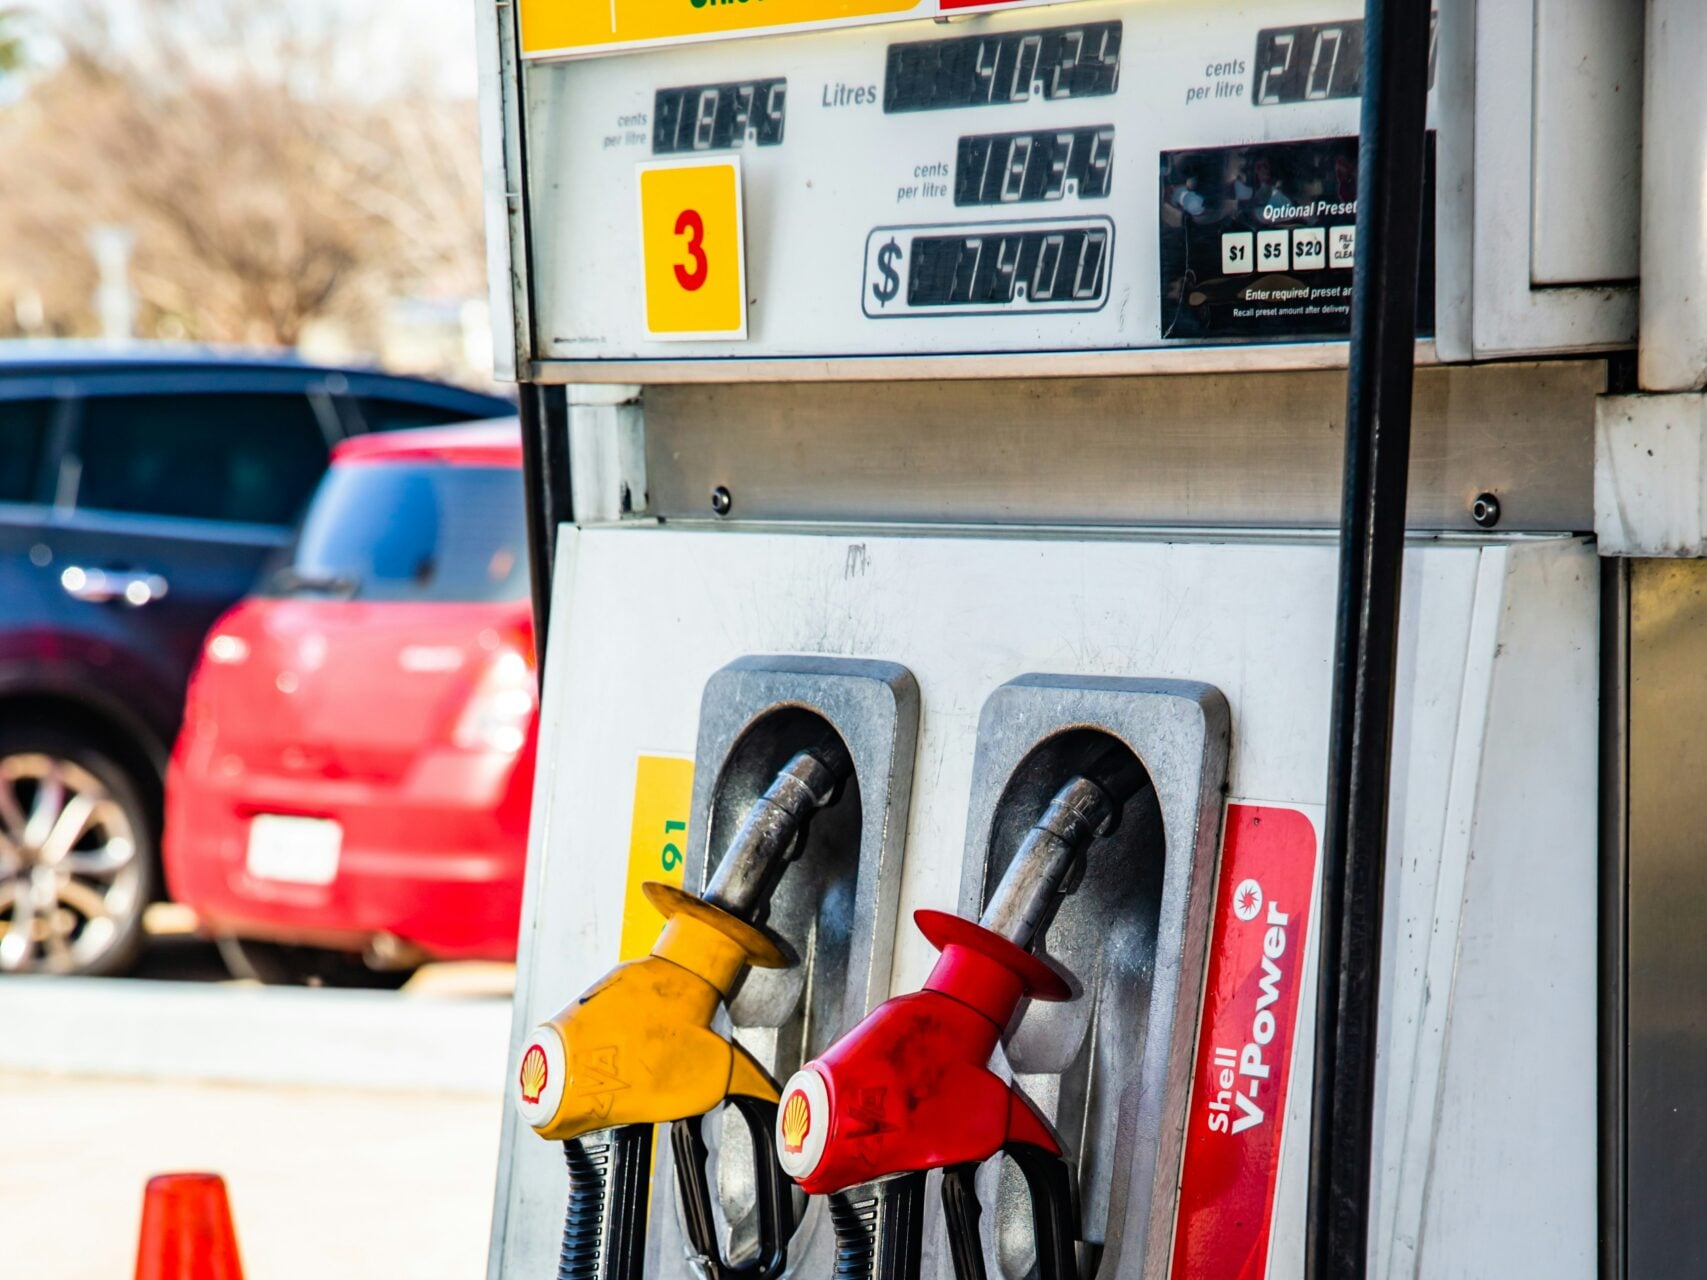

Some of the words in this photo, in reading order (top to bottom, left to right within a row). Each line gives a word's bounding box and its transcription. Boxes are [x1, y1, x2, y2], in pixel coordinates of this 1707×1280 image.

[1205, 59, 1246, 78] cents
[821, 83, 877, 108] Litres
[1186, 86, 1210, 104] per
[1215, 80, 1244, 99] litre
[617, 113, 648, 128] cents
[604, 135, 621, 149] per
[625, 131, 647, 145] litre
[913, 162, 949, 178] cents
[897, 186, 917, 203] per
[922, 181, 947, 197] litre
[1263, 202, 1314, 222] Optional
[1317, 200, 1357, 216] Preset
[673, 209, 708, 291] 3
[1229, 245, 1245, 262] $1
[1263, 243, 1282, 260] $5
[1295, 240, 1322, 258] $20
[1334, 250, 1354, 260] CLEA
[872, 236, 903, 308] $
[1245, 289, 1269, 301] Enter
[1272, 287, 1310, 301] required
[1311, 286, 1340, 300] preset
[1233, 308, 1254, 317] Recall
[1255, 307, 1277, 318] preset
[1279, 306, 1303, 316] amount
[1305, 305, 1320, 314] after
[1321, 305, 1350, 315] delivery
[661, 820, 686, 871] 91
[1231, 900, 1289, 1136] V-Power
[1208, 1047, 1238, 1134] Shell
